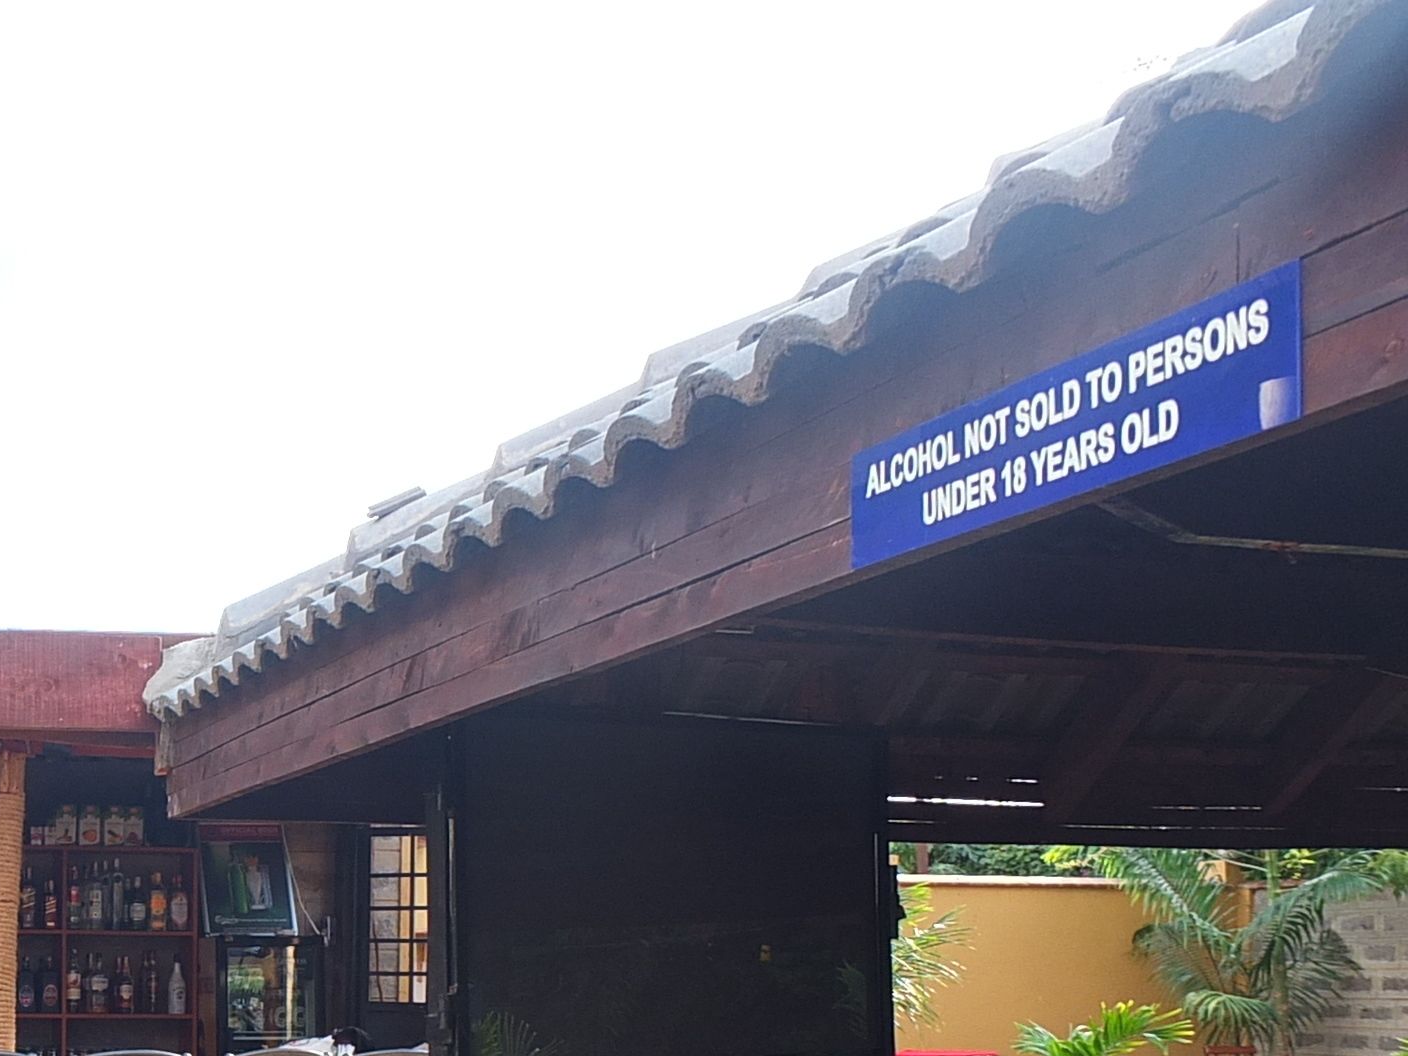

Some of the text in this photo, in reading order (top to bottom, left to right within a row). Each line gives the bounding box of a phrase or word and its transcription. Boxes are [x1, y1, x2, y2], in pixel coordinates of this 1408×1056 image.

[866, 299, 1270, 498] ALCOHOL NOT SOLD TO PERSONS
[922, 399, 1180, 525] UNDER 18 YEARS OLD
